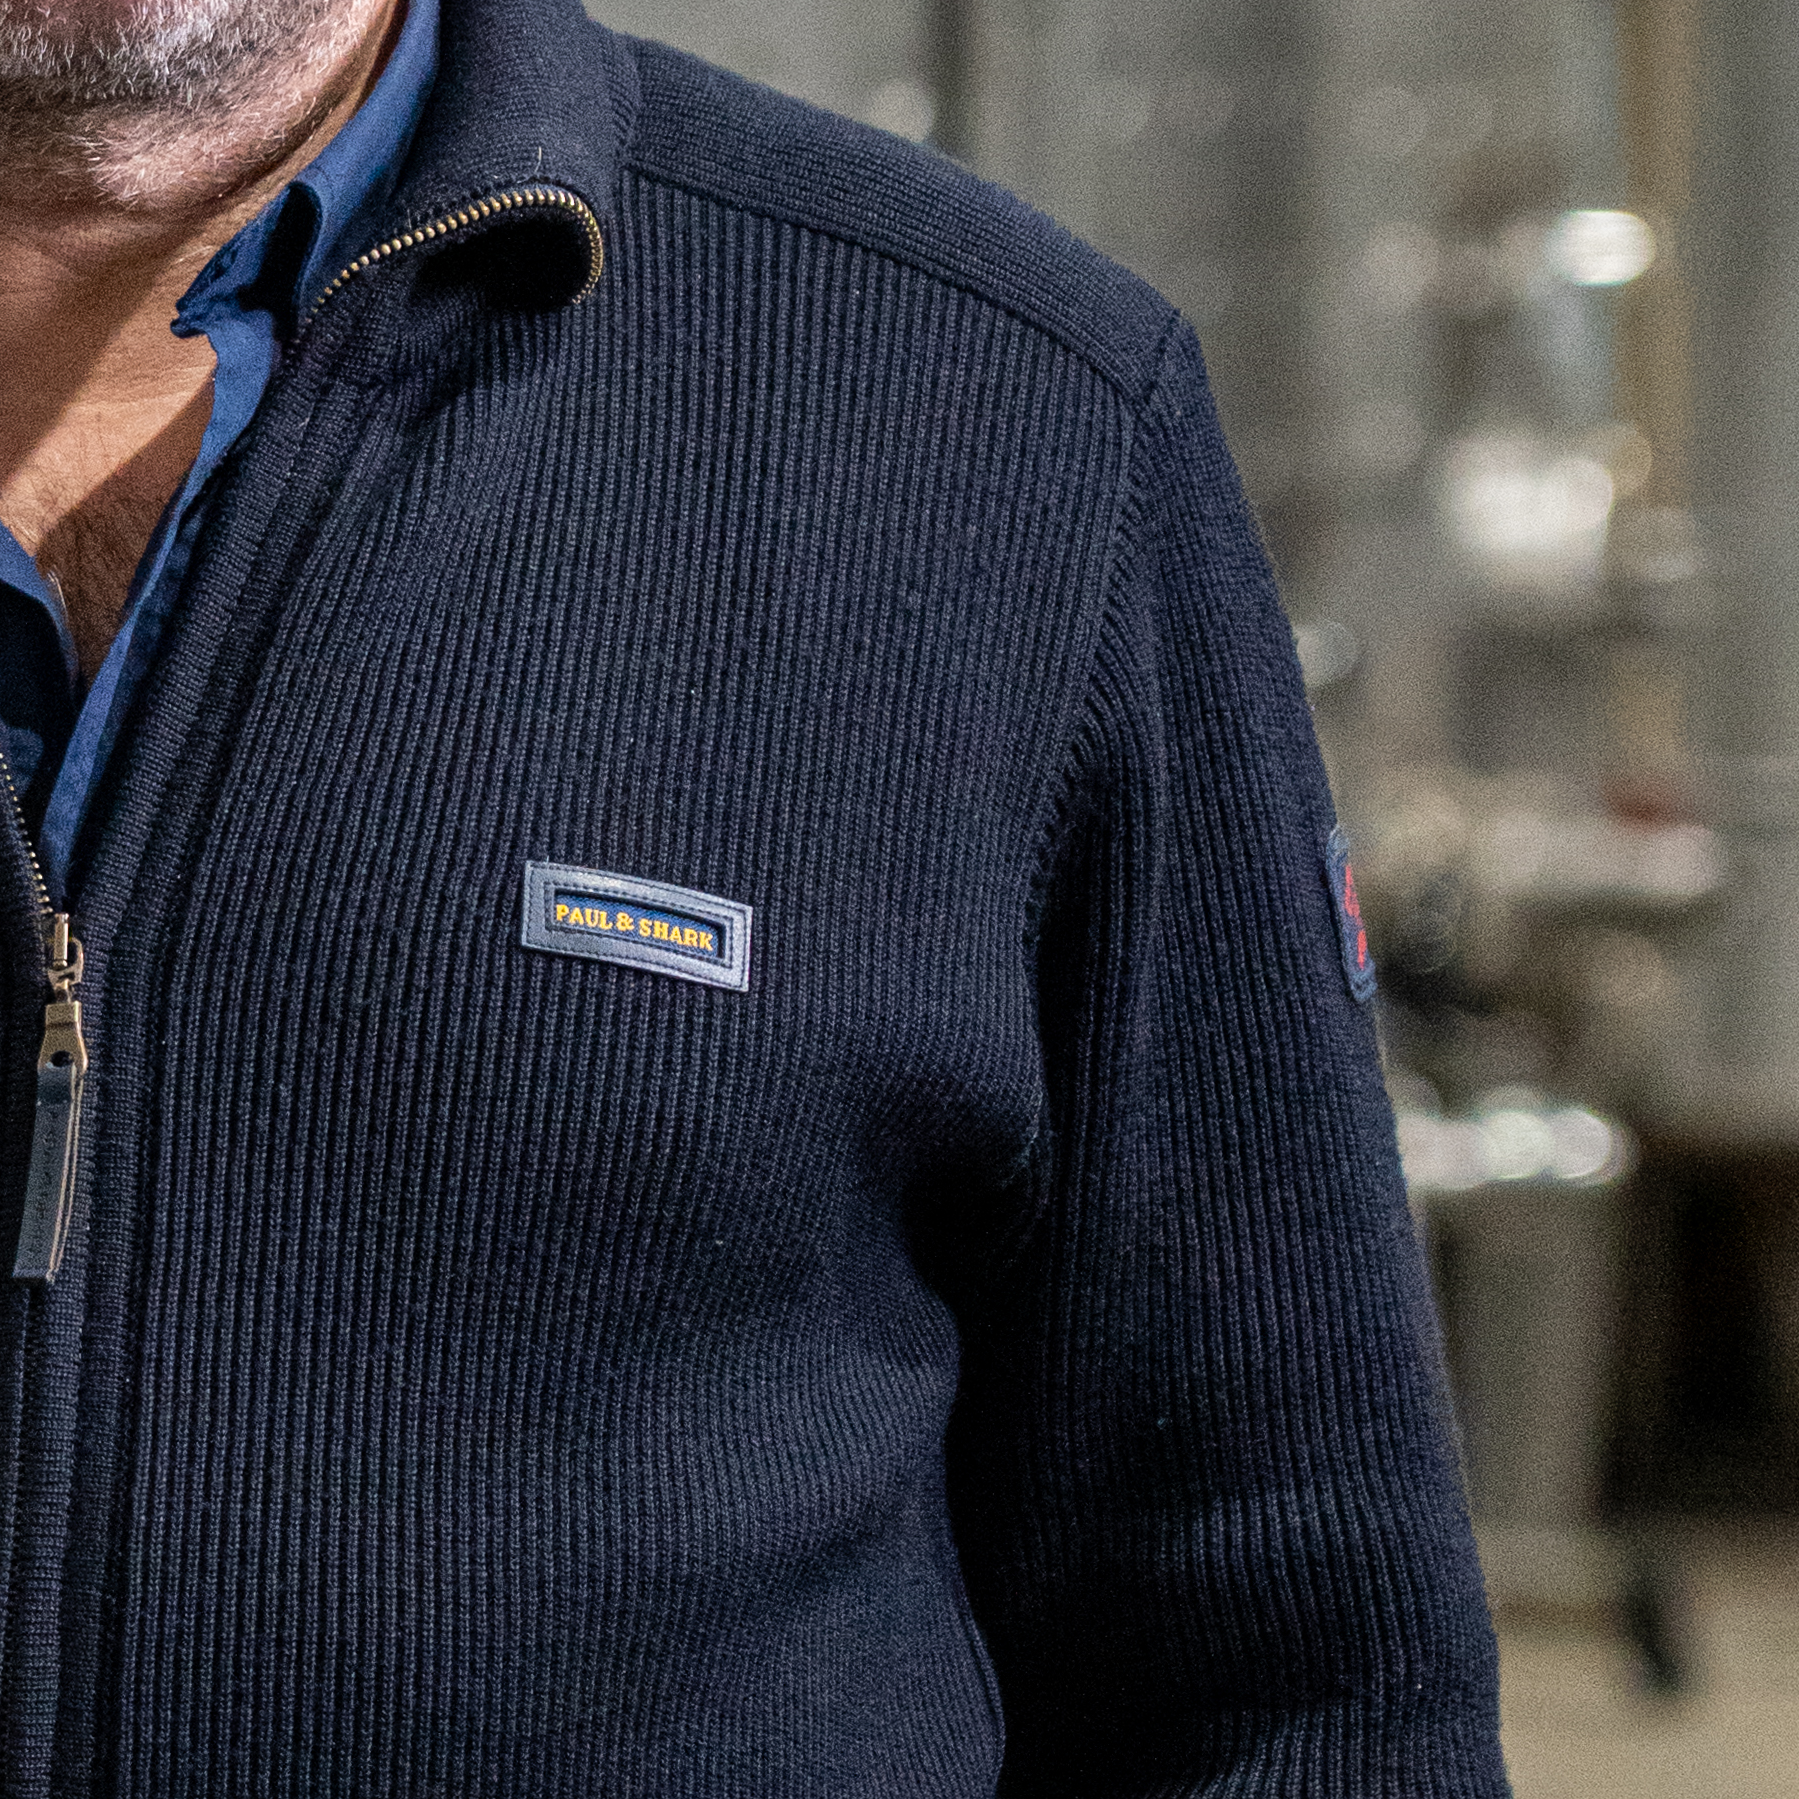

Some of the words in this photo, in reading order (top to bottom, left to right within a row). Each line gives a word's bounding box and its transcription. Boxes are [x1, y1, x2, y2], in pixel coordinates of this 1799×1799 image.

[555, 903, 613, 930] PAUL
[616, 912, 635, 932] &
[638, 917, 713, 951] SHARK
